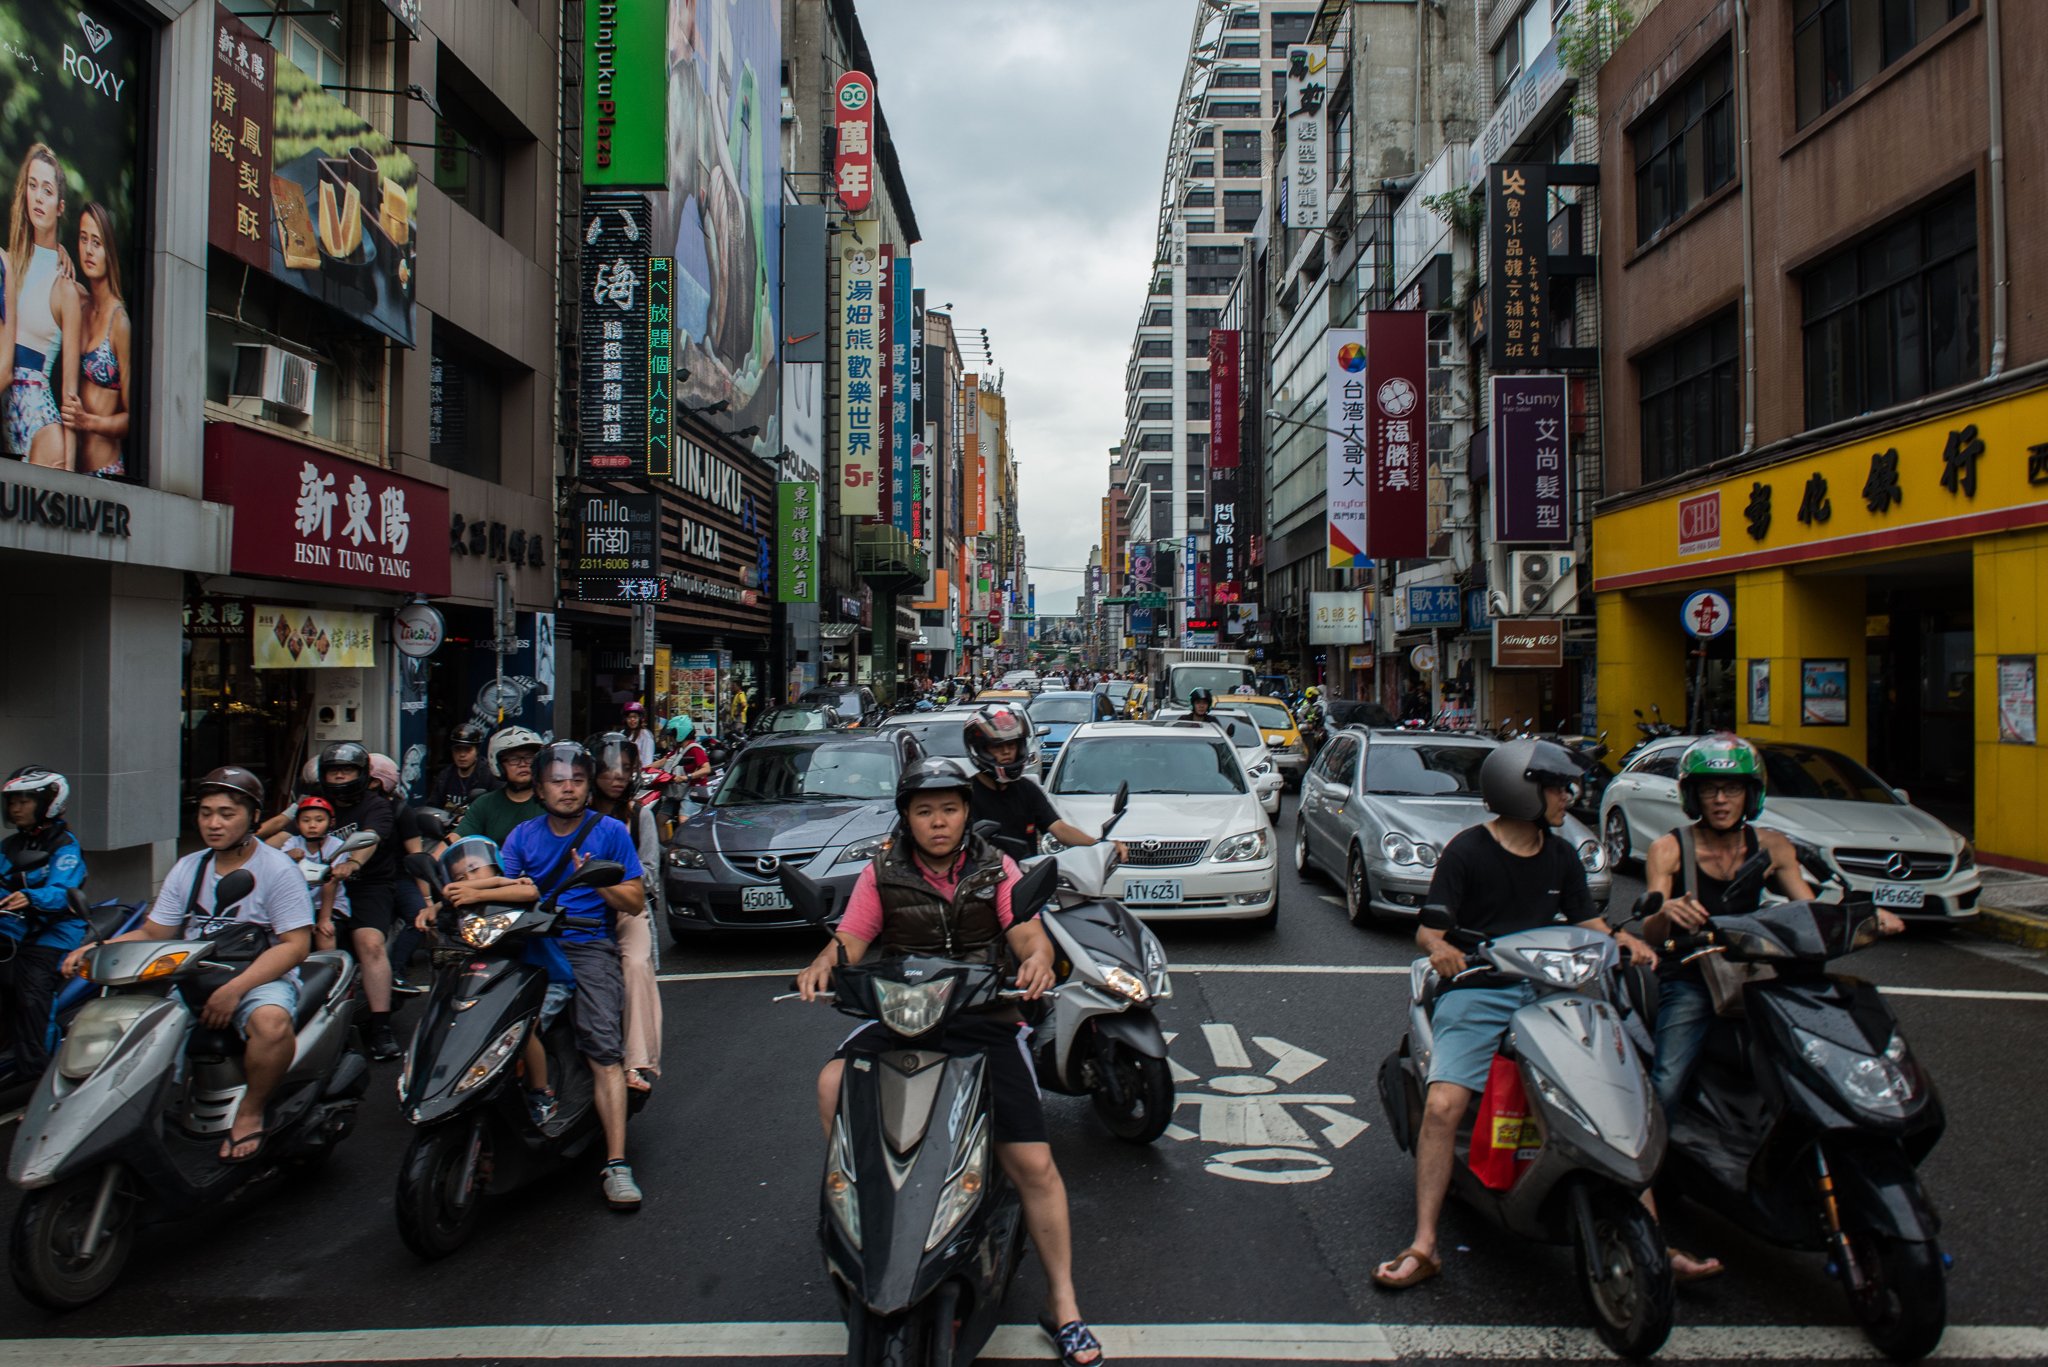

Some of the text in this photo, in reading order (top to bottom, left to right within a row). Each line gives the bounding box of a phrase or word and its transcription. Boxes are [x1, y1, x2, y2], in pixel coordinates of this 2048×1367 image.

[62, 42, 125, 103] ROXY
[218, 26, 265, 80] 新東陽
[218, 52, 265, 92] HSIN TUNG YANG
[596, 0, 615, 166] hinjuku Plaza
[211, 75, 237, 164] 精緻
[838, 119, 869, 198] 萬年
[237, 116, 263, 243] 鳳梨酥
[1297, 209, 1319, 225] 3F
[585, 208, 642, 311] 八海
[845, 279, 875, 457] 湯姆熊歡樂世界
[1516, 392, 1560, 408] Sunny
[844, 462, 875, 488] 5F
[1385, 419, 1410, 492] 福勝亭
[1534, 417, 1561, 529] 艾尚髮型
[294, 460, 411, 555] 新東陽
[587, 498, 629, 523] Milla
[1681, 498, 1718, 539] CHB
[586, 526, 630, 555] 米勒
[681, 517, 721, 563] PLAZA
[294, 542, 412, 579] HSIN TUNG YANG
[579, 558, 650, 570] 2311-6006 休息
[1412, 588, 1458, 611] 歌林
[193, 625, 245, 634] TUNG YANG
[473, 639, 531, 648] LONES
[1501, 634, 1559, 648] Xining 169
[1125, 884, 1180, 900] ATV-6231
